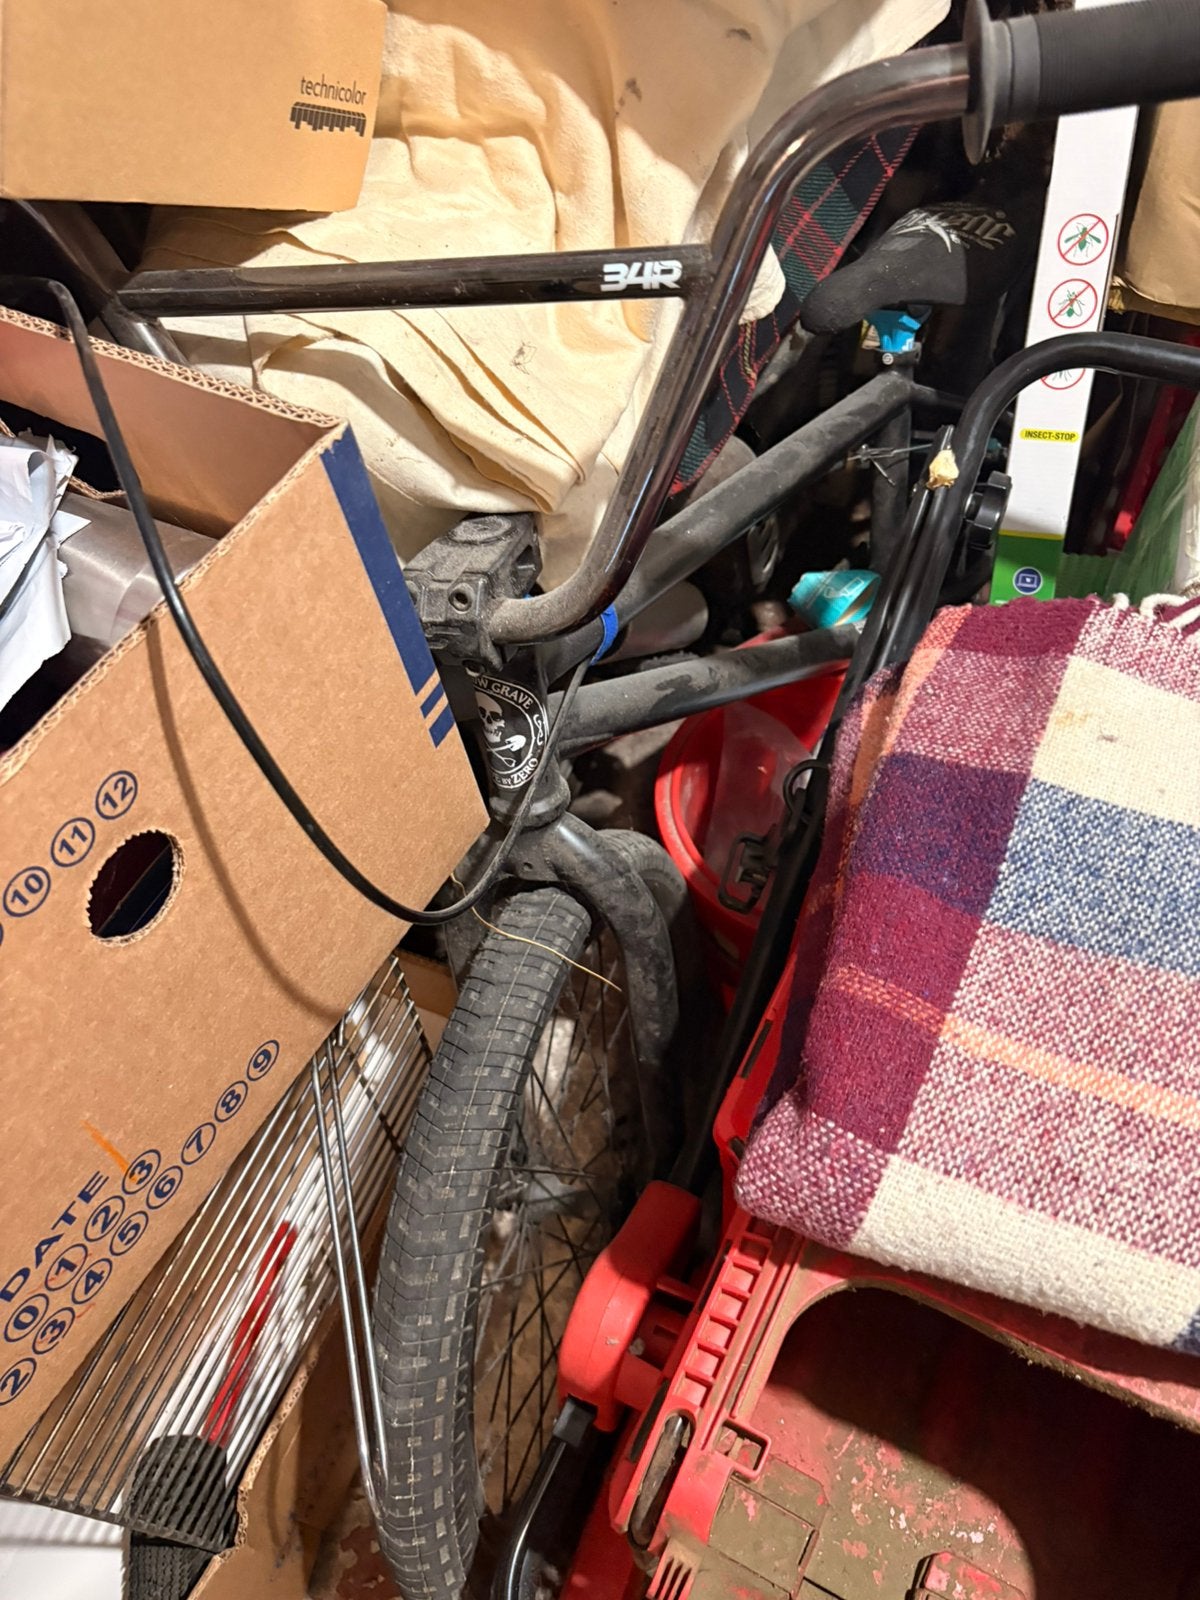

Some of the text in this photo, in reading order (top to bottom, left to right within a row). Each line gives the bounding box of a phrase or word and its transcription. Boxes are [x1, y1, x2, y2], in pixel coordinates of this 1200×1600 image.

[301, 74, 367, 105] technicolor
[1024, 430, 1077, 441] INSECT-STOP
[491, 683, 534, 709] GRAVE
[511, 758, 539, 783] ZERO
[11, 776, 133, 906] 10 11 12
[0, 1170, 109, 1302] DATE
